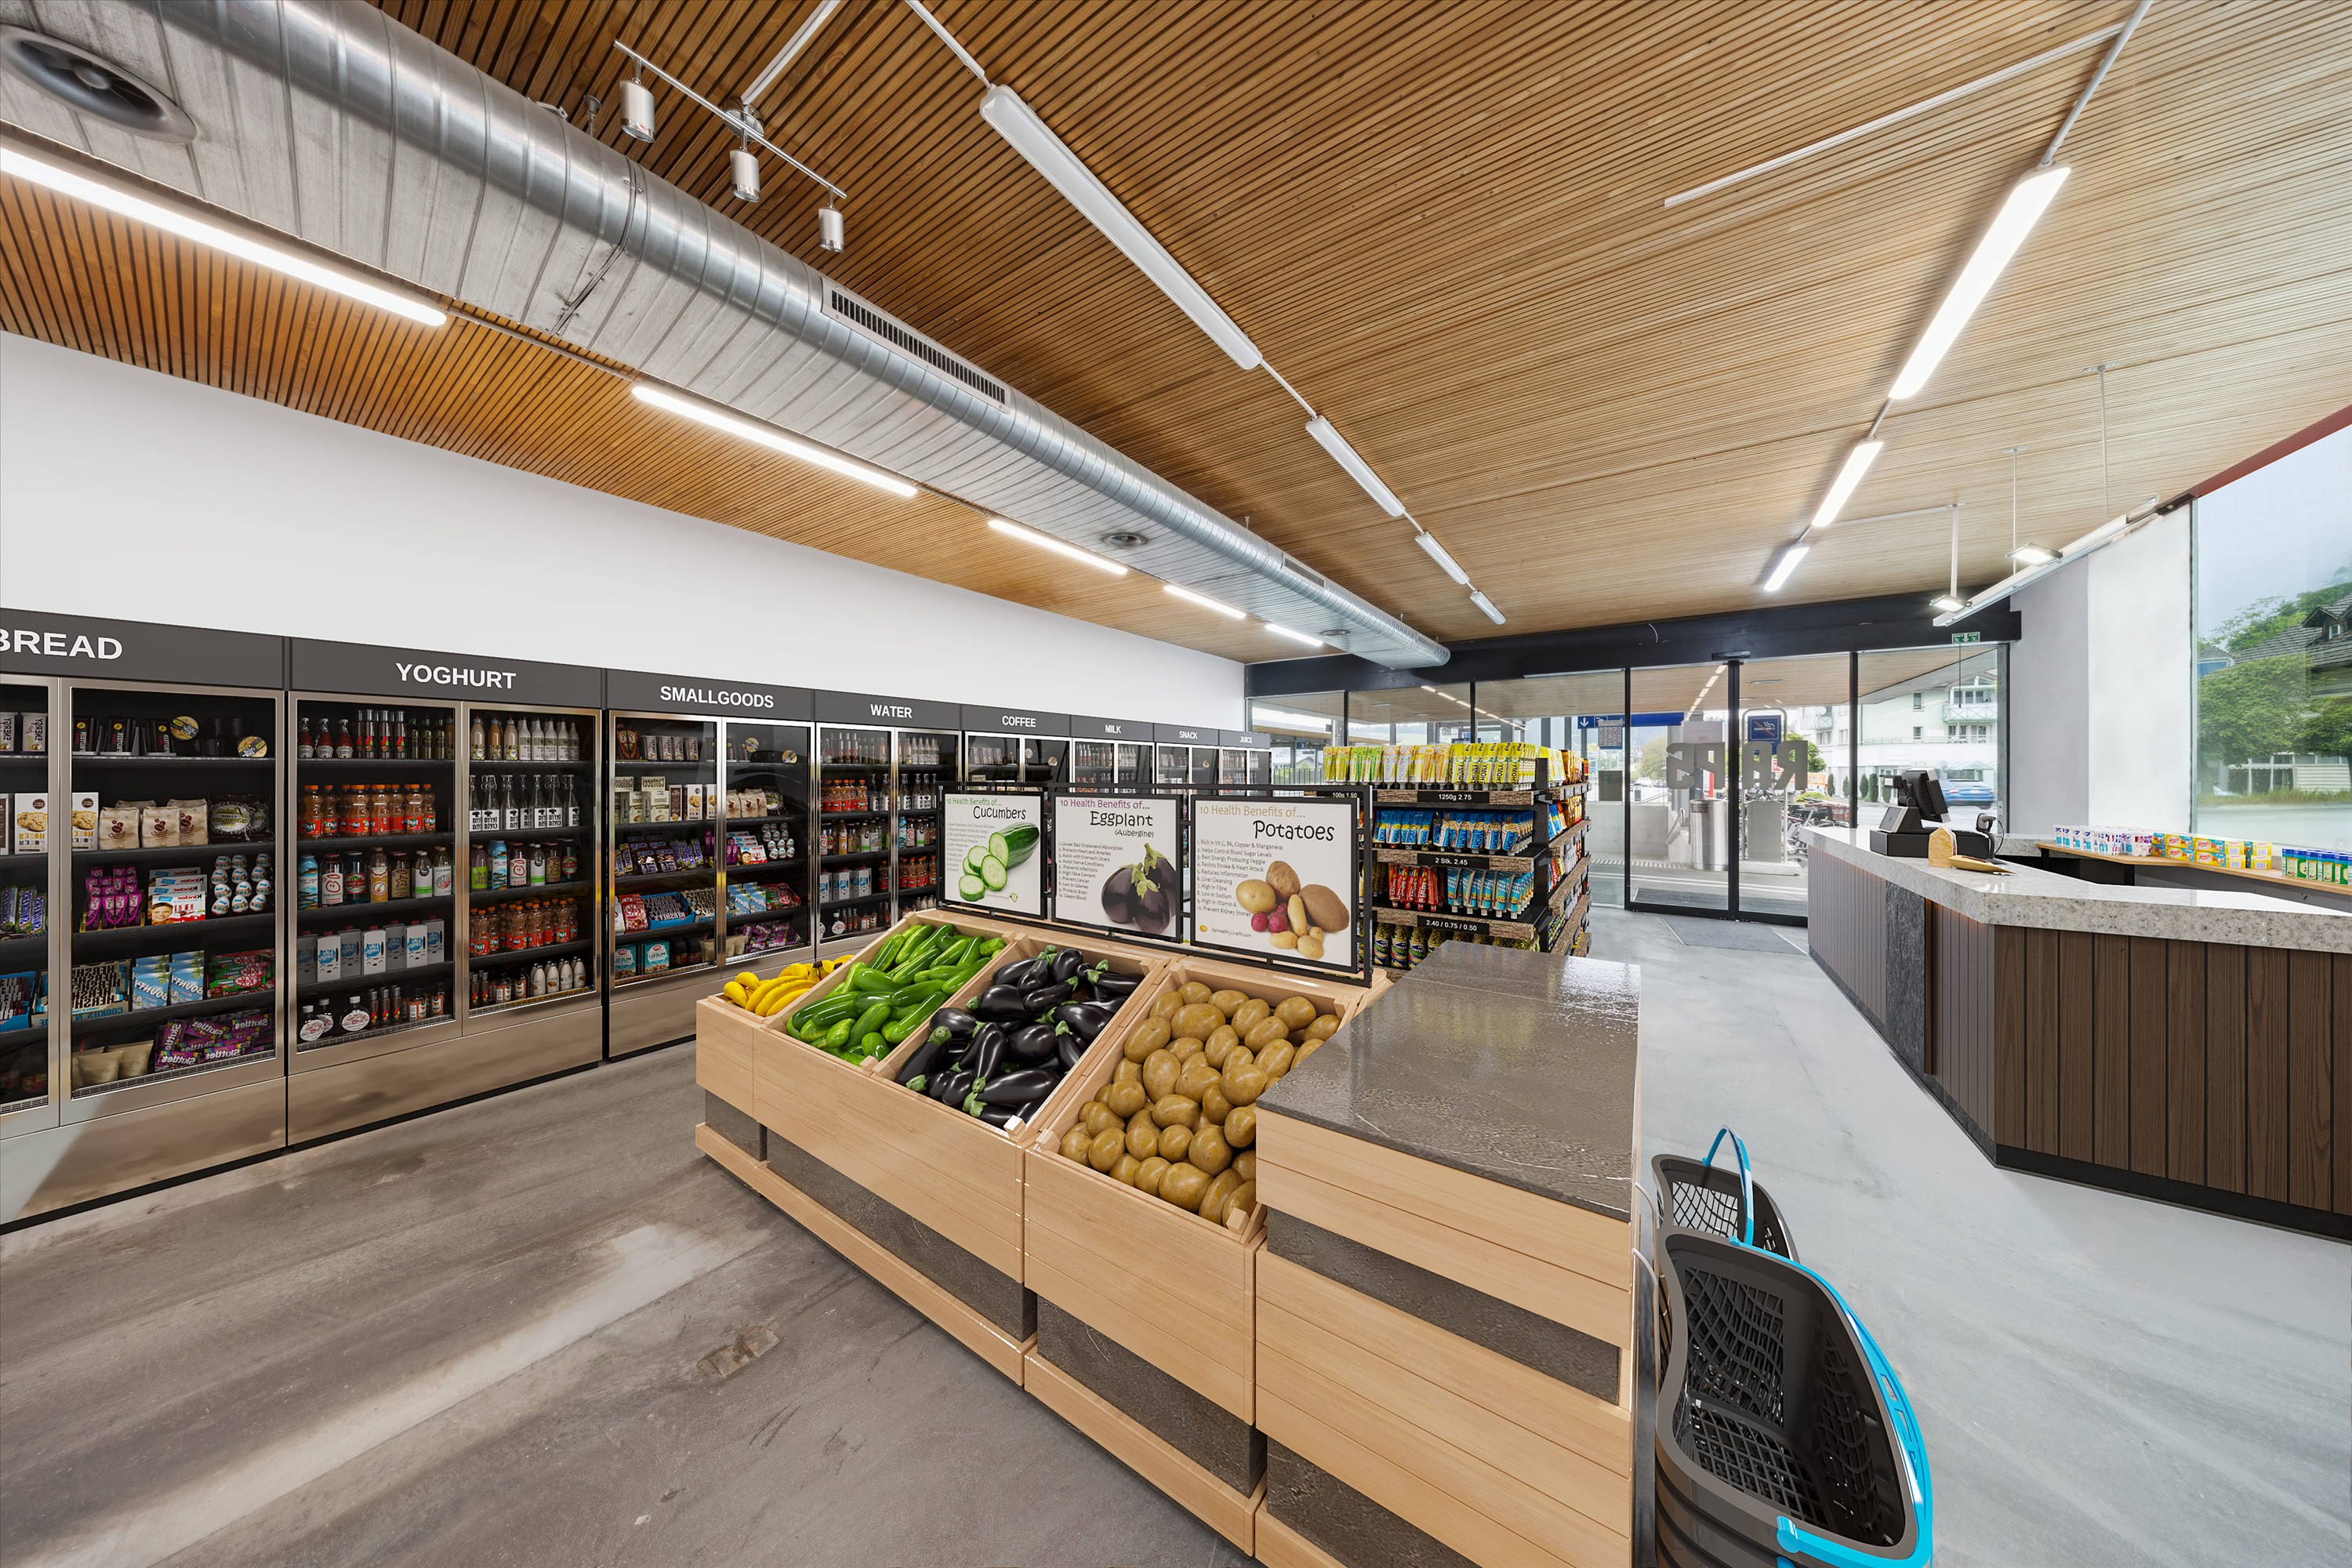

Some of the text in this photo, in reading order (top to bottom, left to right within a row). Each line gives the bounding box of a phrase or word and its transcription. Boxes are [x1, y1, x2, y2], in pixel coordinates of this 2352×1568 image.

[396, 662, 517, 689] YOGHURT
[660, 685, 774, 708] SMALLGOODS
[870, 704, 912, 718] WATER
[1002, 716, 1036, 727] COFFEE
[1105, 724, 1121, 733] MILK
[1178, 731, 1198, 740] SNACK
[1239, 735, 1253, 744] JUICE
[1098, 800, 1131, 809] Benefits
[974, 806, 1026, 819] Cucumbers
[1200, 806, 1209, 815] 10
[1211, 805, 1240, 815] Health
[1244, 806, 1283, 817] Benefits
[1091, 811, 1153, 826] Eggplant
[1253, 820, 1334, 841] Potatoes
